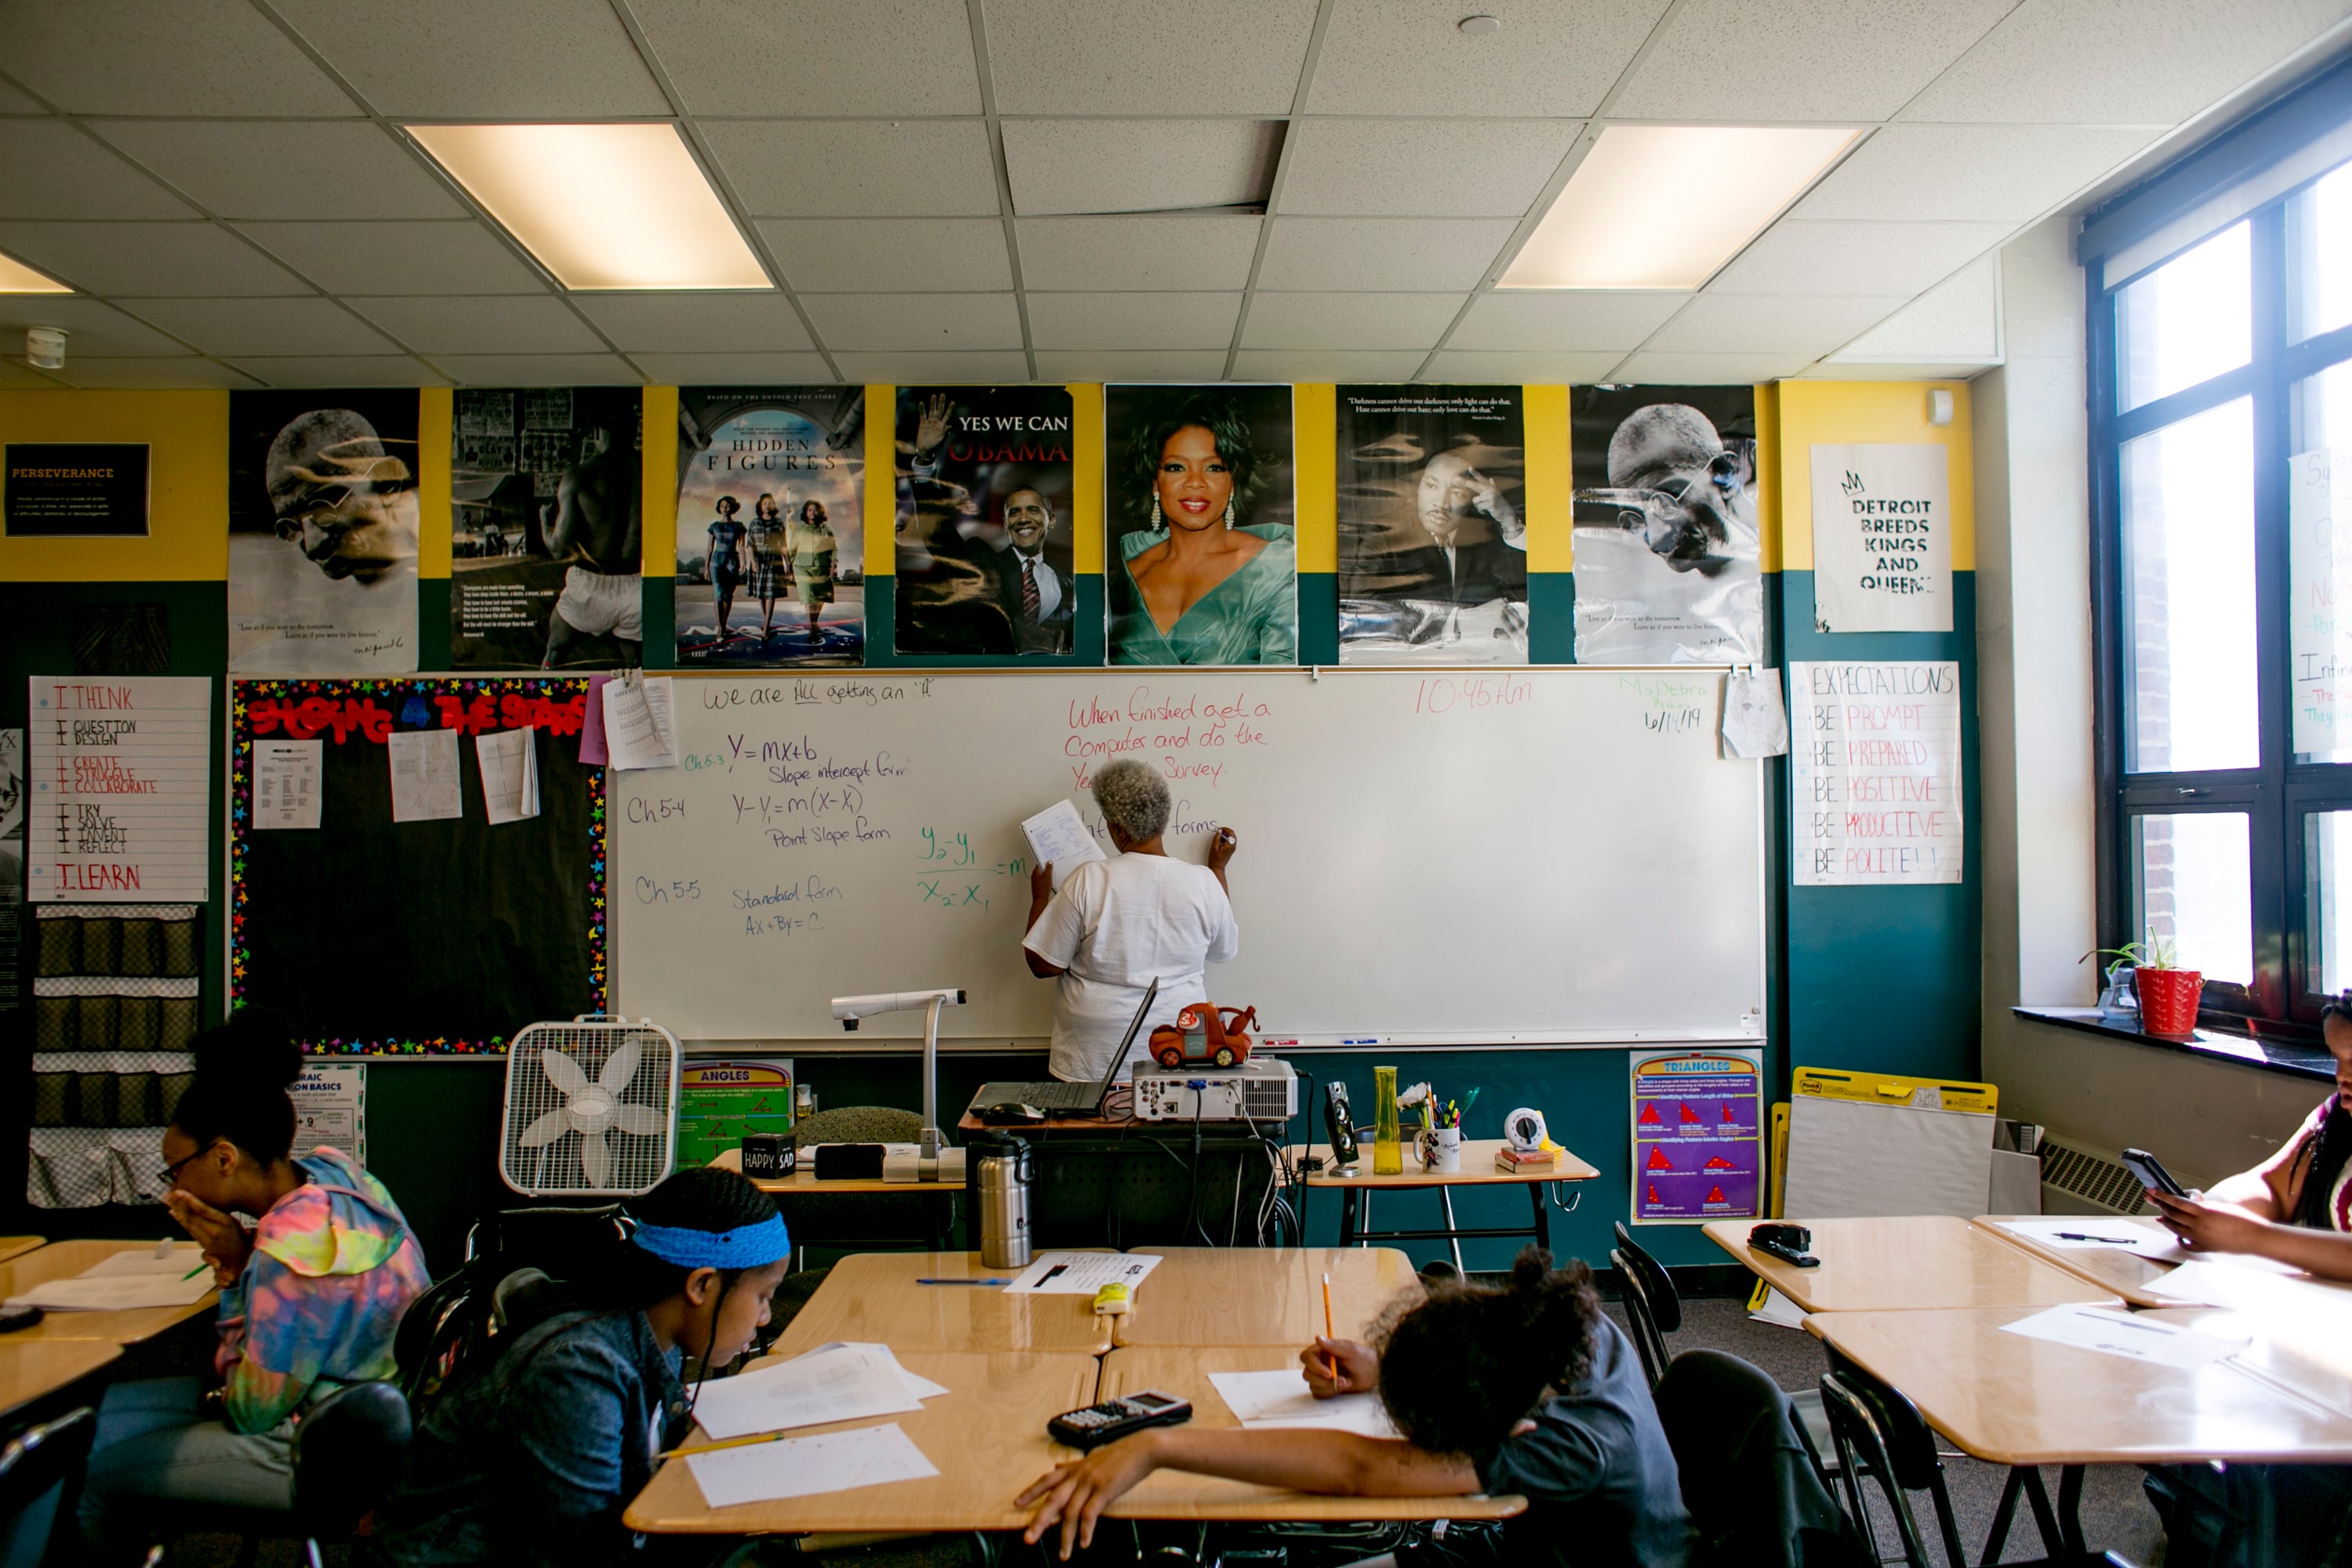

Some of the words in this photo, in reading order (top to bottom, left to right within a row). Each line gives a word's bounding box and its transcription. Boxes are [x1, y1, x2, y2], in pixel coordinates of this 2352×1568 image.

[959, 416, 990, 431] YES
[994, 416, 1023, 431] WE
[1029, 416, 1068, 431] CAN
[733, 439, 809, 452] HIDDEN
[948, 440, 1071, 463] OBAMA
[707, 455, 836, 470] FIGURES
[12, 468, 114, 478] PERSEVERANCE
[1852, 499, 1932, 514] DETROIT
[1860, 518, 1929, 534] BREEDS
[1864, 537, 1928, 552] KINGS
[1876, 557, 1919, 572] AND
[1813, 666, 1954, 695] EXPECTATIONS
[53, 685, 69, 710] I
[71, 685, 135, 710] THINK
[703, 683, 746, 710] We
[750, 688, 785, 706] are
[826, 681, 878, 706] getting
[880, 685, 904, 701] an
[1416, 677, 1492, 714] 10:45
[1069, 694, 1121, 729] When
[1127, 685, 1197, 722] finished
[1203, 693, 1250, 728] get
[1254, 702, 1272, 717] a
[400, 695, 430, 728] 4
[434, 695, 498, 737] THE
[1814, 705, 1837, 731] BE
[1846, 704, 1926, 731] PROMPT
[56, 719, 68, 734] I
[74, 720, 136, 735] QUESTION
[6, 735, 16, 749] X
[56, 732, 67, 746] I
[75, 732, 118, 746] DESIGN
[1065, 726, 1147, 763] Computer
[1154, 724, 1191, 749] and
[1199, 722, 1225, 747] do
[1234, 722, 1269, 746] the
[1814, 740, 1836, 767] BE
[1848, 739, 1928, 767] PREPARED
[56, 755, 68, 770] I
[74, 755, 122, 770] CREATE
[56, 768, 68, 782] I
[74, 768, 136, 782] STRUGGLE
[768, 764, 812, 786] Slope
[818, 757, 871, 782] intercept
[56, 780, 69, 794] I
[74, 780, 158, 794] COLLABORATE
[1814, 776, 1838, 803] BE
[1846, 776, 1937, 802] POSITIVE
[56, 803, 69, 817] I
[74, 804, 100, 818] TRY
[1171, 799, 1221, 835] forms
[56, 816, 69, 829] I
[78, 816, 117, 829] SOLVE
[1814, 811, 1836, 838] BE
[1845, 811, 1945, 838] PRODUCTIVE
[56, 828, 70, 842] I
[78, 827, 129, 843] INVENT
[764, 826, 808, 848] Point
[811, 825, 850, 848] Slope
[855, 815, 891, 841] form
[60, 840, 71, 853] I
[78, 840, 127, 854] REFLECT
[1814, 848, 1835, 874] BE
[56, 863, 77, 890] I
[78, 864, 141, 891] LEARN
[635, 876, 669, 905] Ch
[732, 882, 800, 910] Standard
[806, 873, 843, 904] form
[1664, 1061, 1730, 1073] TRIANGLES
[700, 1070, 750, 1082] ANGLES
[310, 1083, 342, 1091] BASICS
[744, 1152, 775, 1169] HAPPY
[779, 1152, 795, 1170] SAD
